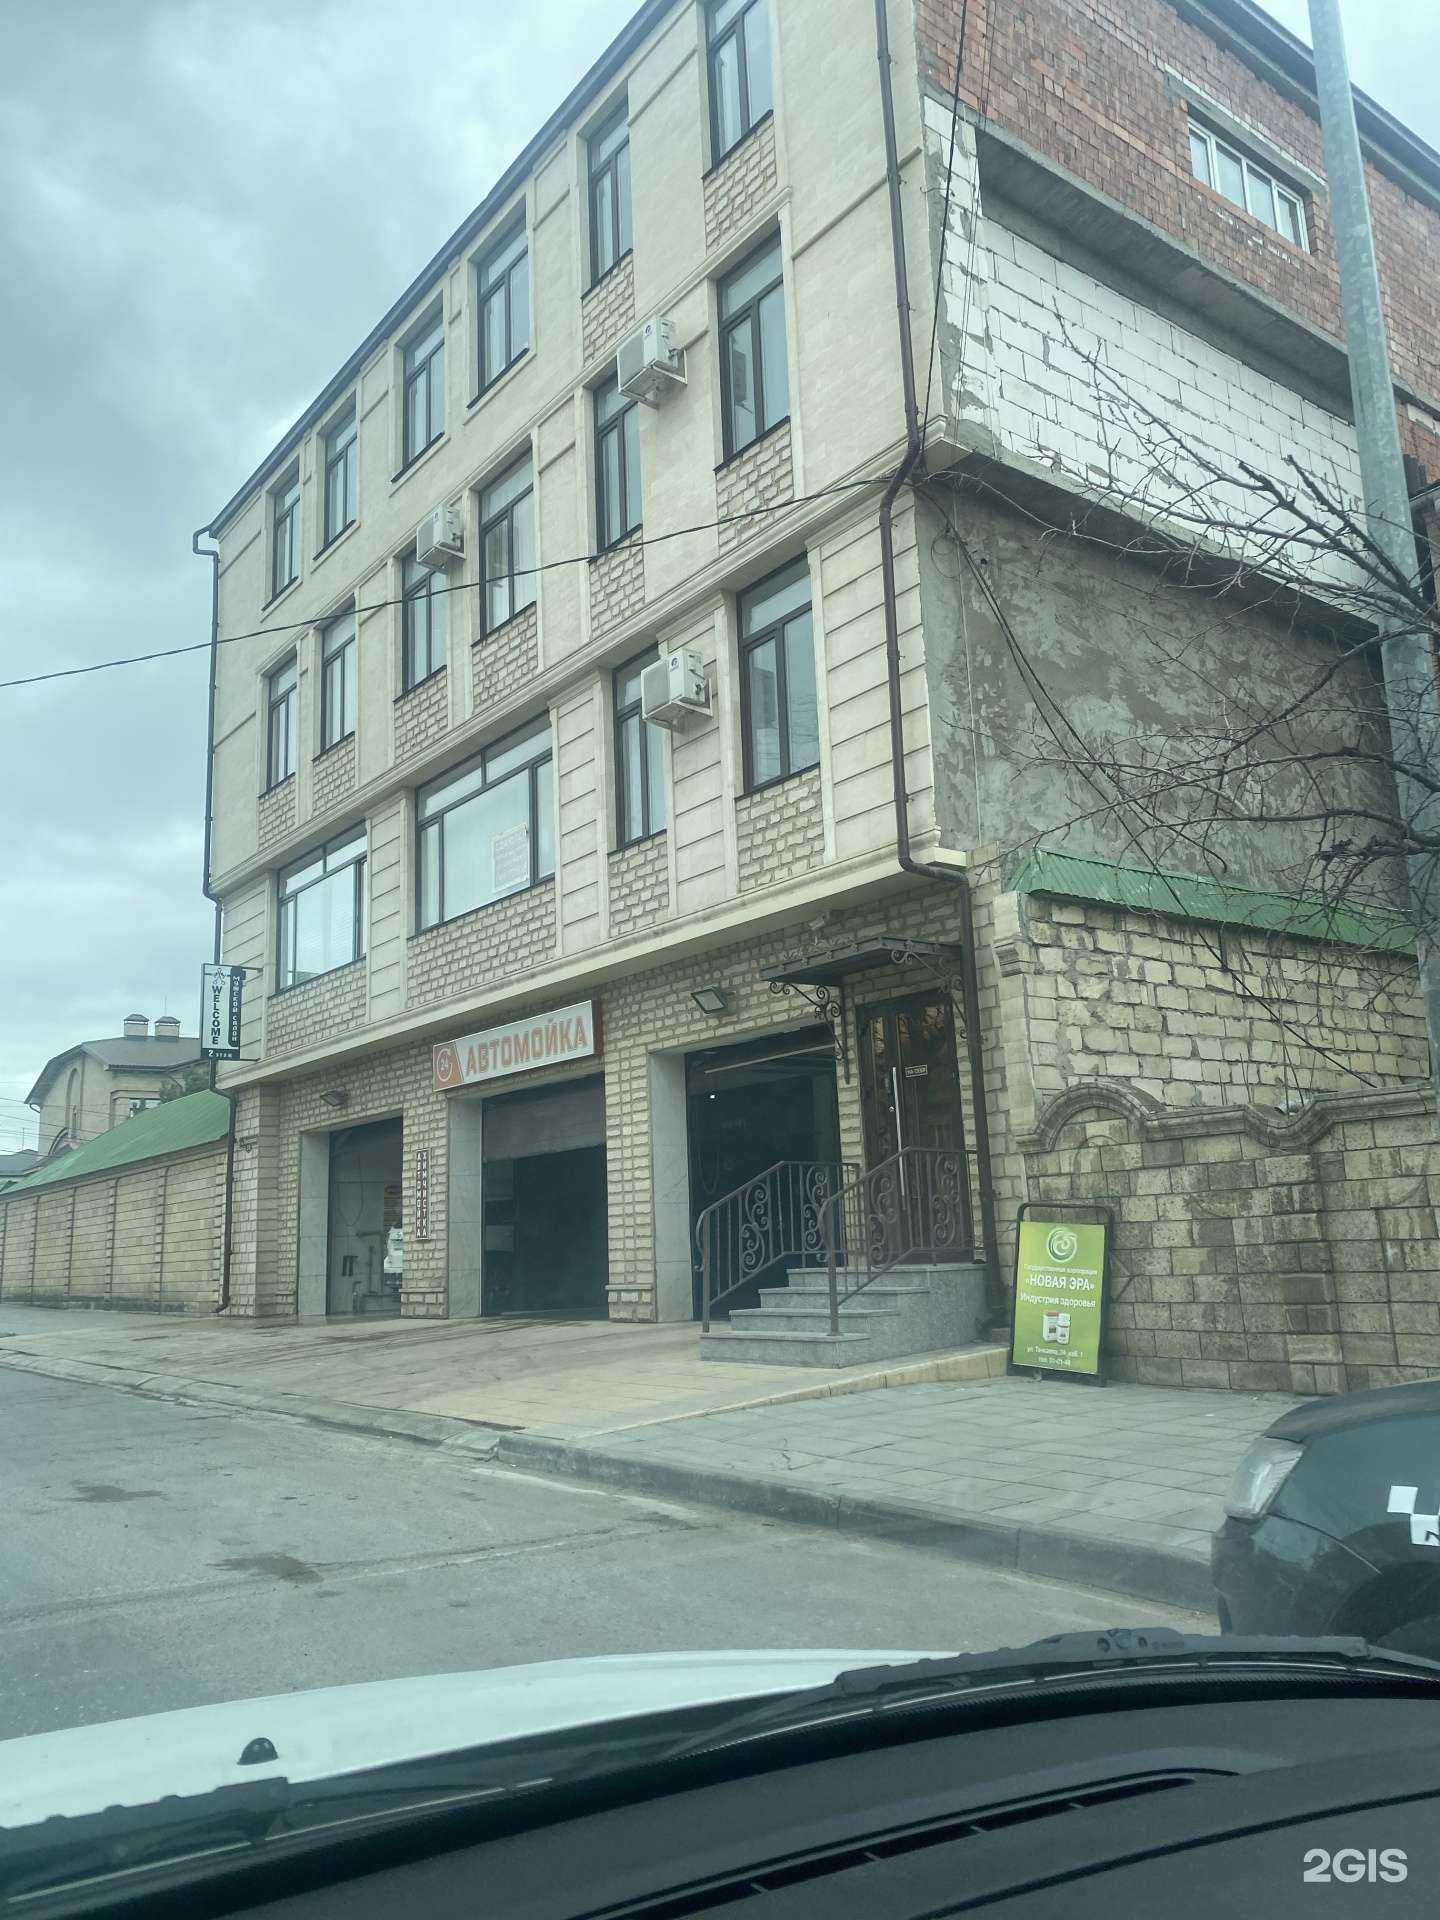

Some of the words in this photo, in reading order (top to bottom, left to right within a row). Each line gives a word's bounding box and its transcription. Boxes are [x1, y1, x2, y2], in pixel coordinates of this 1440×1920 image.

[211, 985, 222, 1044] WELCOME
[466, 1016, 588, 1076] АВТОМОЙКА
[1020, 1290, 1059, 1305] Индустрия
[1060, 1297, 1096, 1309] здоровья
